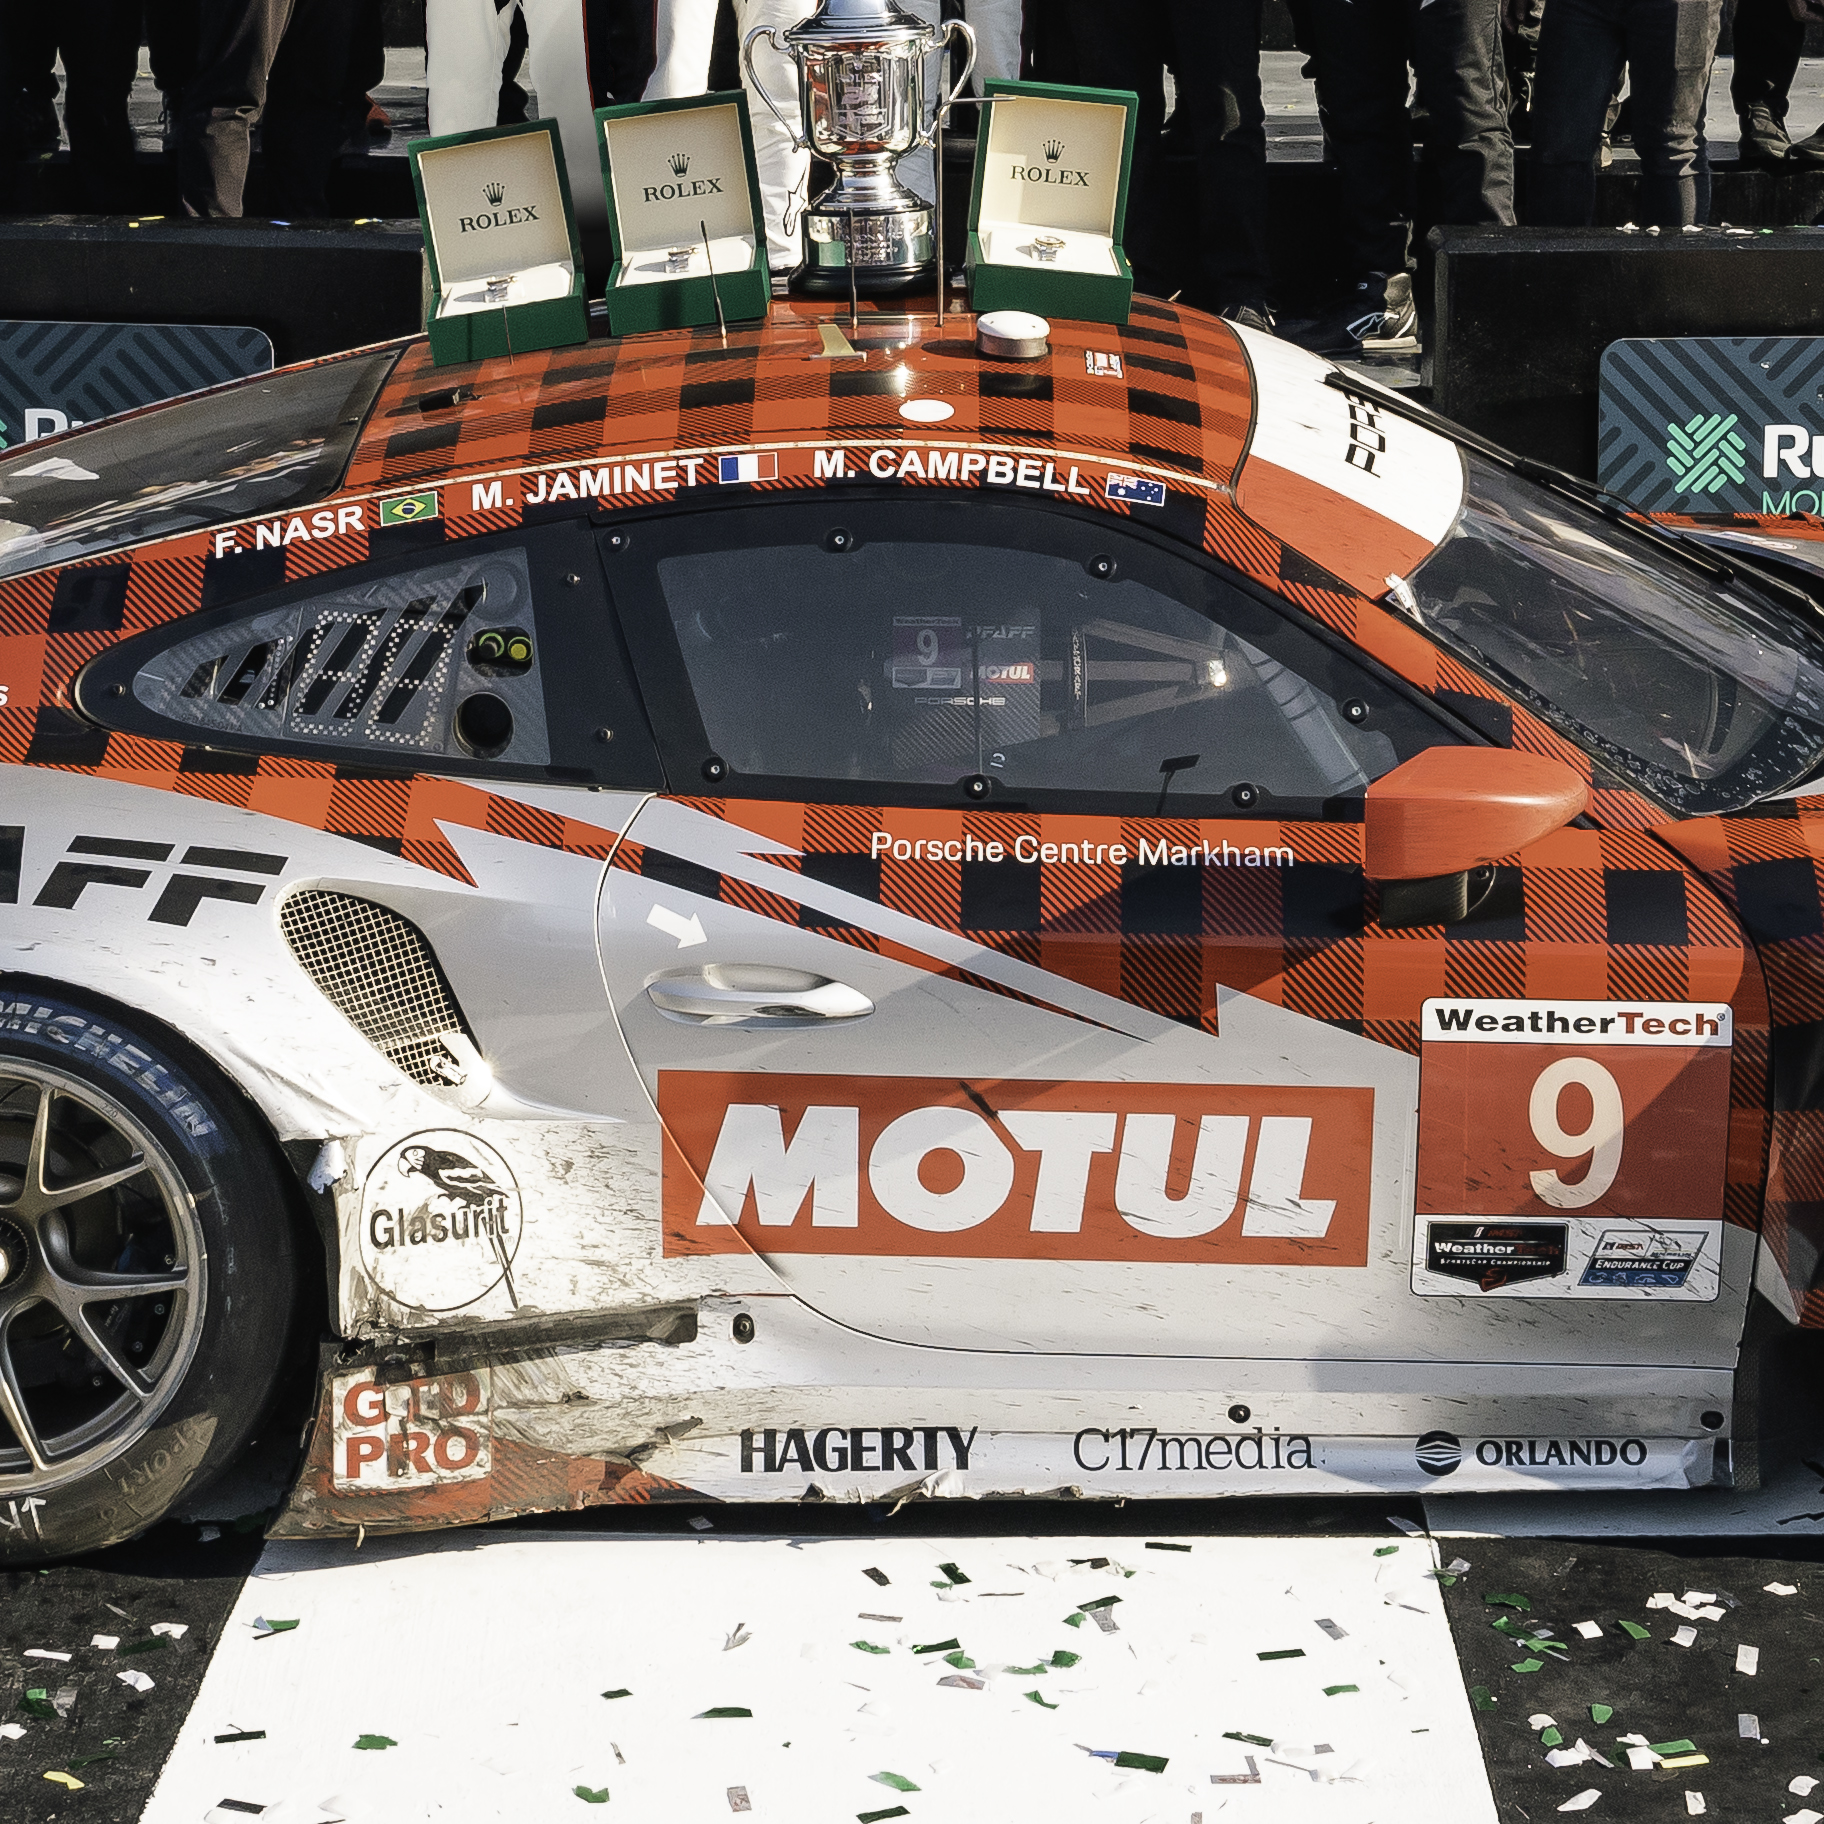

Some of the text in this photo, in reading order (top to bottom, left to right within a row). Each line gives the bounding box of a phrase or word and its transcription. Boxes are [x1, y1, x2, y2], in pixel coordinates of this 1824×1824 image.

[642, 177, 724, 203] ROLEX
[1010, 164, 1090, 188] ROLEX
[458, 204, 540, 234] ROLEX
[472, 457, 705, 512] M. JAMINET
[813, 448, 1091, 497] M. CAMPBELL
[214, 507, 365, 559] F. NASR
[916, 628, 939, 666] 9
[871, 832, 1294, 867] Porsche Centre Markham
[1435, 1007, 1719, 1037] WeatherTech
[1527, 1056, 1625, 1210] 9
[696, 1101, 1339, 1239] MOTUL
[368, 1194, 510, 1252] Glasurit
[345, 1427, 481, 1480] PRO
[740, 1427, 979, 1473] HAGERTY
[1072, 1427, 1312, 1472] C17media
[1475, 1438, 1648, 1468] ORLANDO
